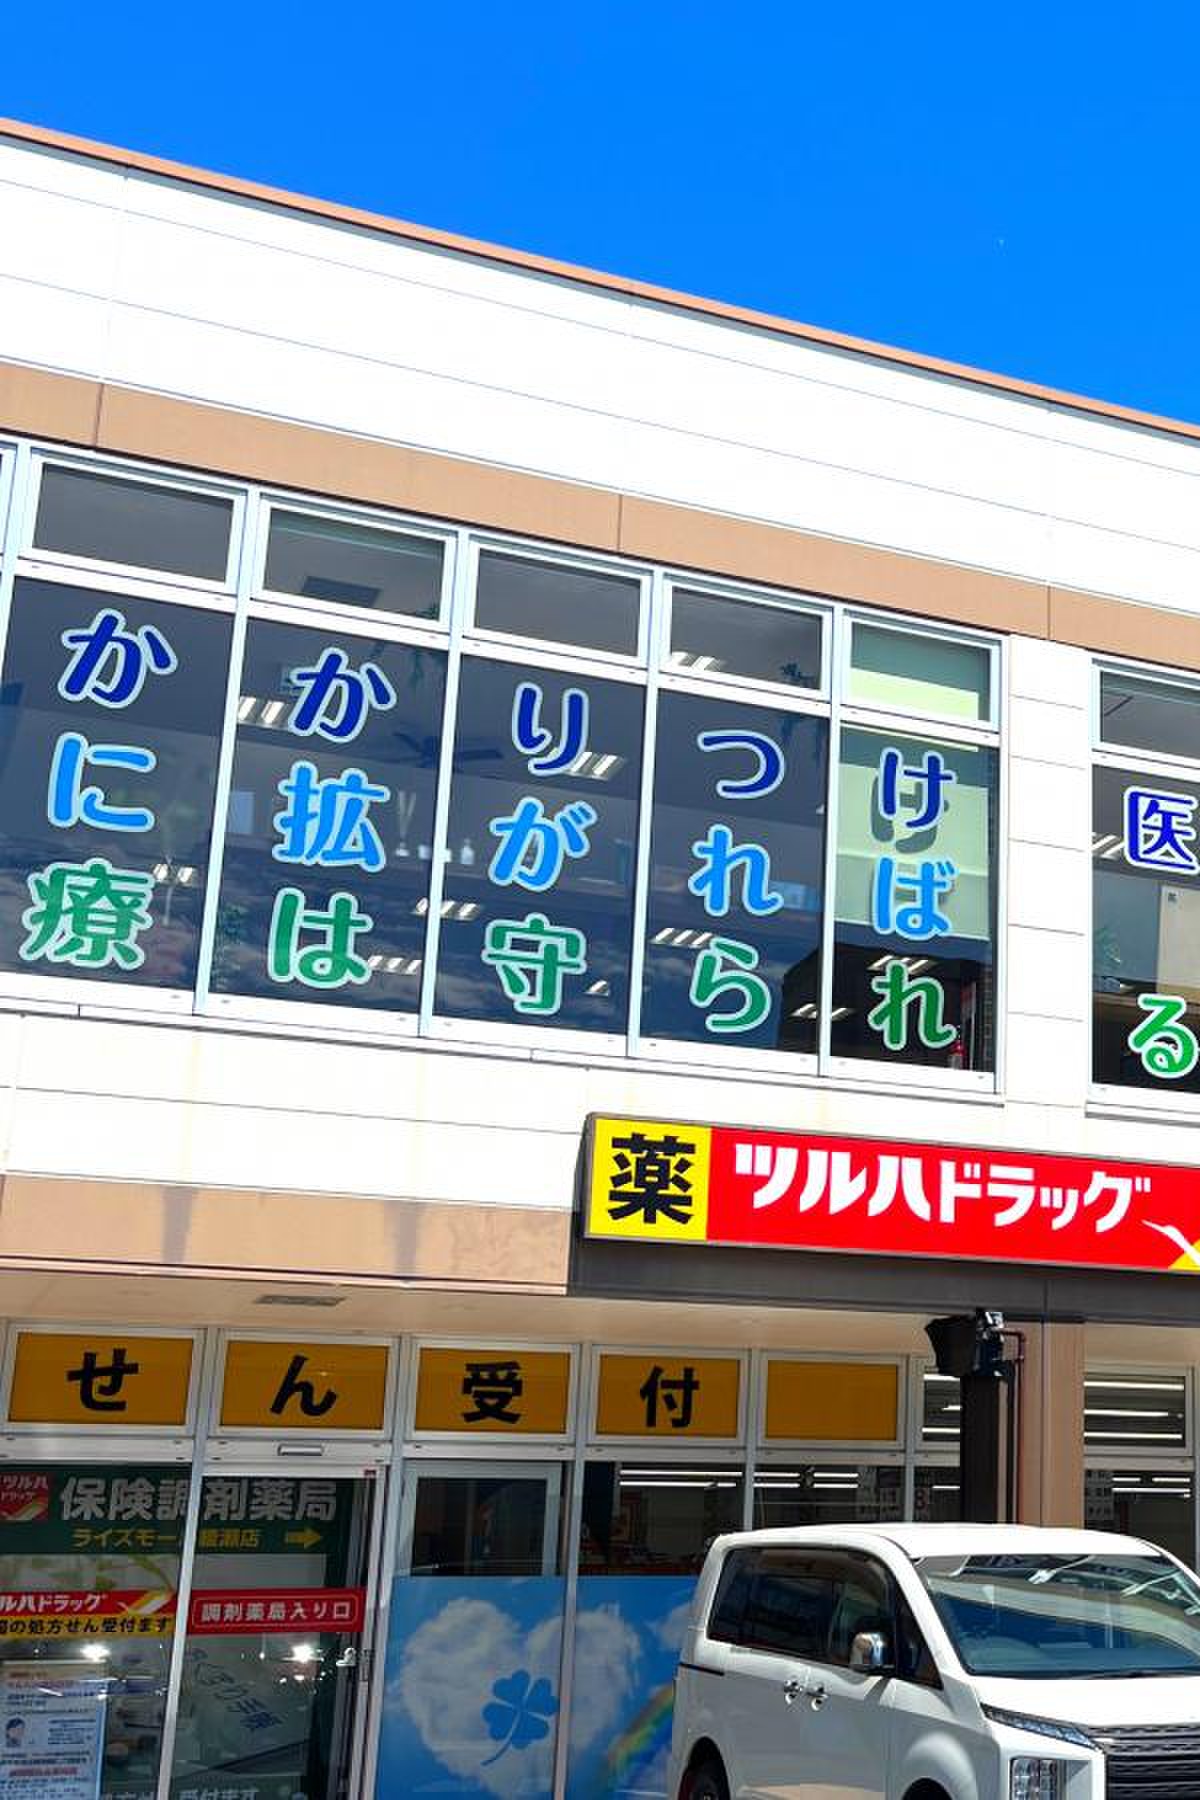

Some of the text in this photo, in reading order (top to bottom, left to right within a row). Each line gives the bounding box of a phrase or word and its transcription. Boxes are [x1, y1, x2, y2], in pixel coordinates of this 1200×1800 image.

[48, 732, 957, 941] に拡がれば
[20, 858, 1200, 1078] 療は守られる
[607, 1132, 697, 1225] 薬
[735, 1143, 1151, 1233] ツルハドラッグ
[67, 1348, 699, 1428] せん受付
[201, 1601, 350, 1622] 調剤薬局入り口
